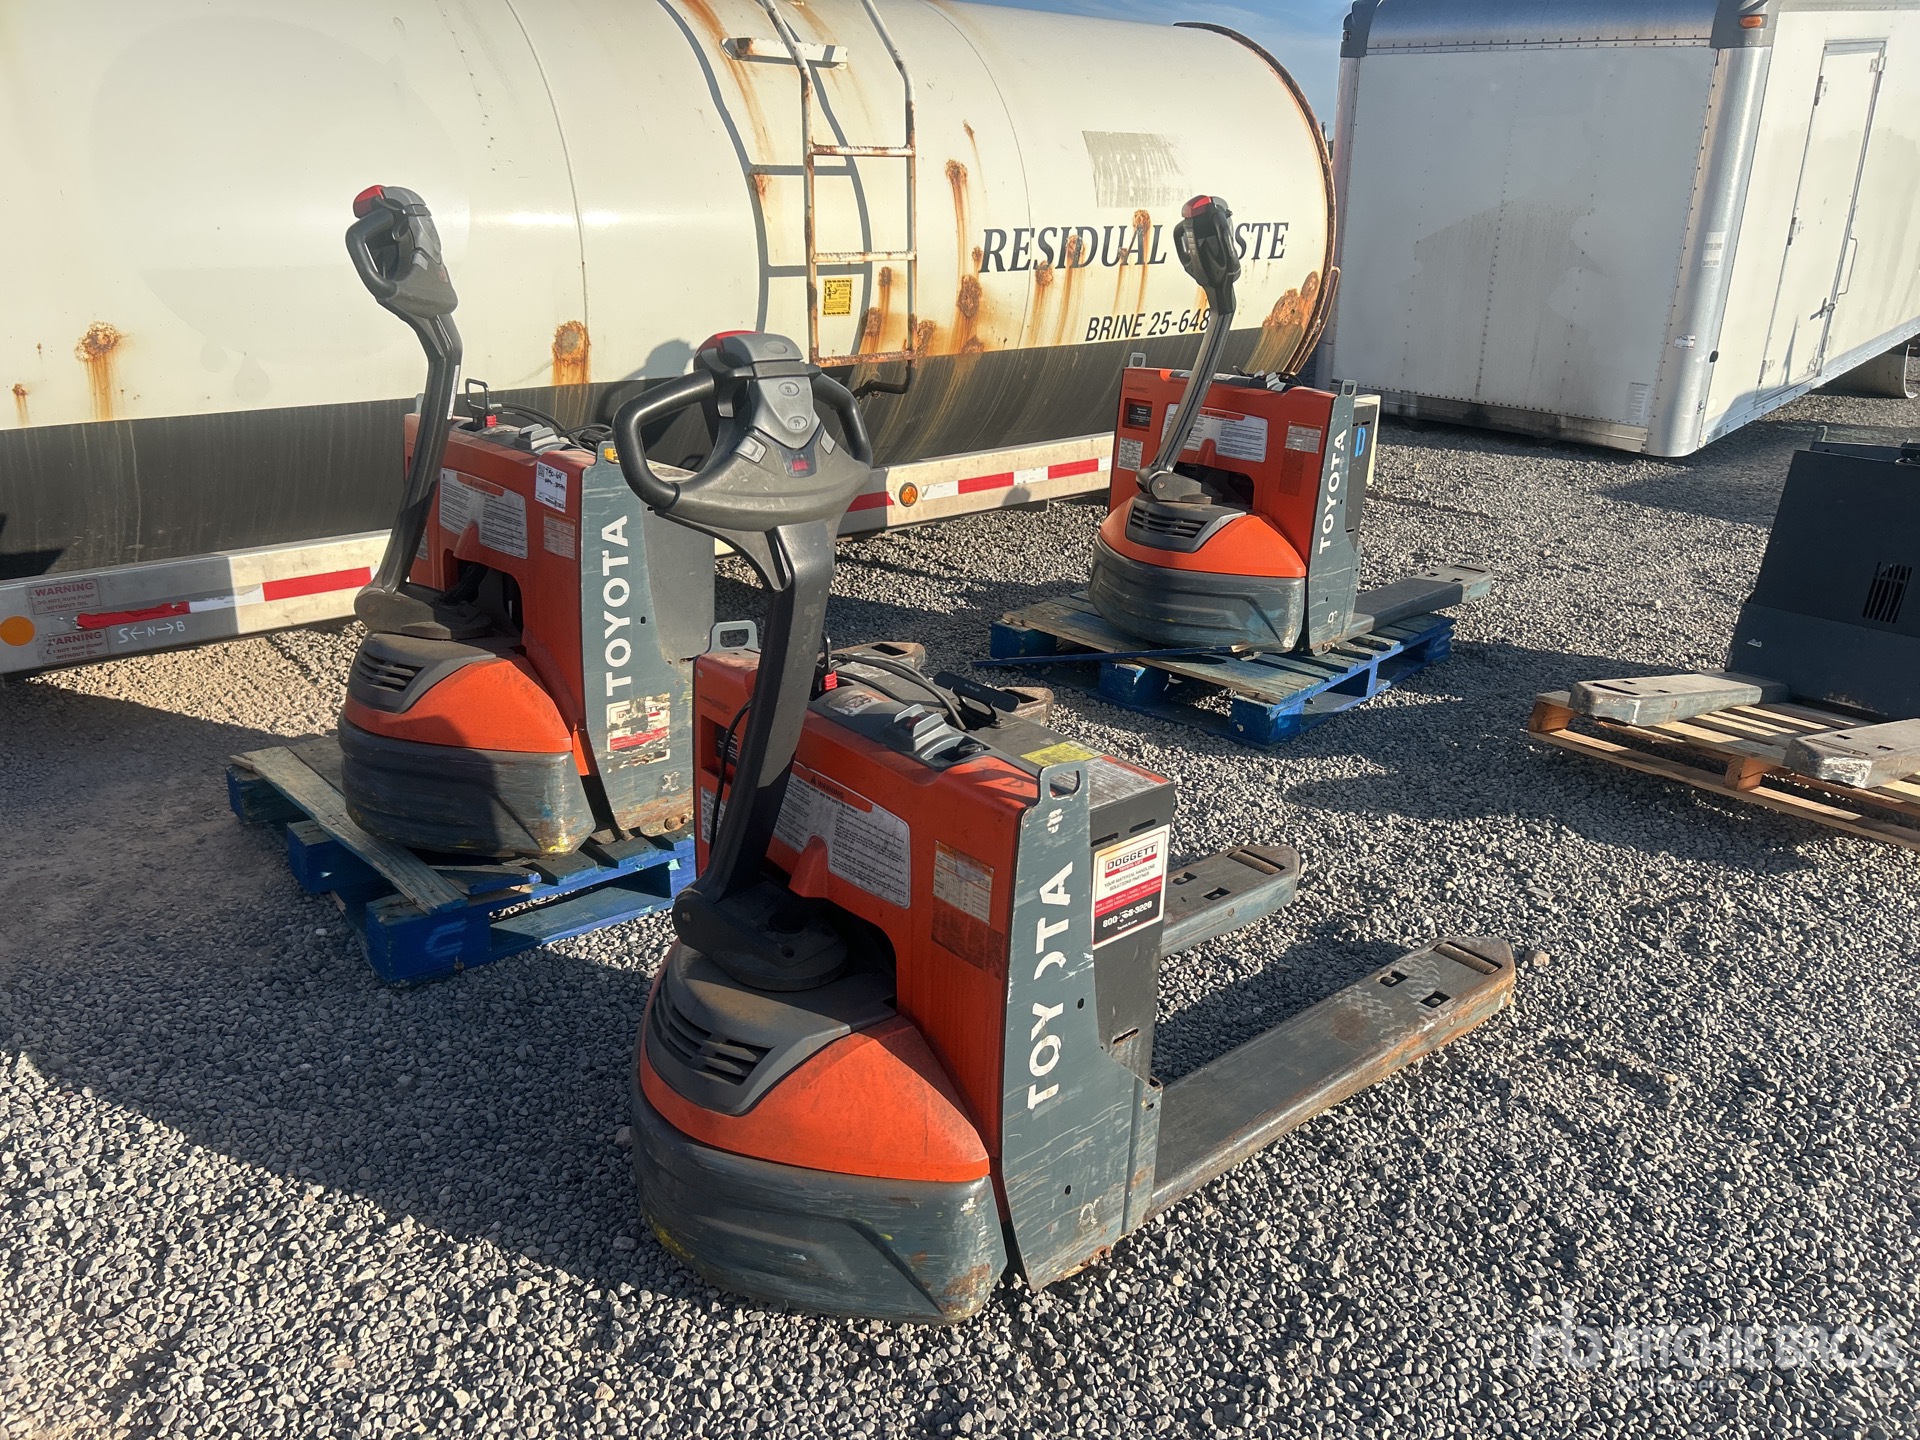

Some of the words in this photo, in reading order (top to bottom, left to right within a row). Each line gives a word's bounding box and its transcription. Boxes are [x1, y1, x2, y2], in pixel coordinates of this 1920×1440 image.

[978, 224, 1167, 273] RESIDUAL
[1234, 222, 1289, 260] STE
[1085, 313, 1146, 341] BRINE
[1355, 427, 1366, 457] D
[1319, 429, 1347, 554] TOYOTA
[34, 582, 94, 597] WARNING
[602, 515, 632, 697] TOYOTA
[118, 628, 129, 644] S
[147, 627, 156, 636] N
[1107, 845, 1156, 870] DOGGETT
